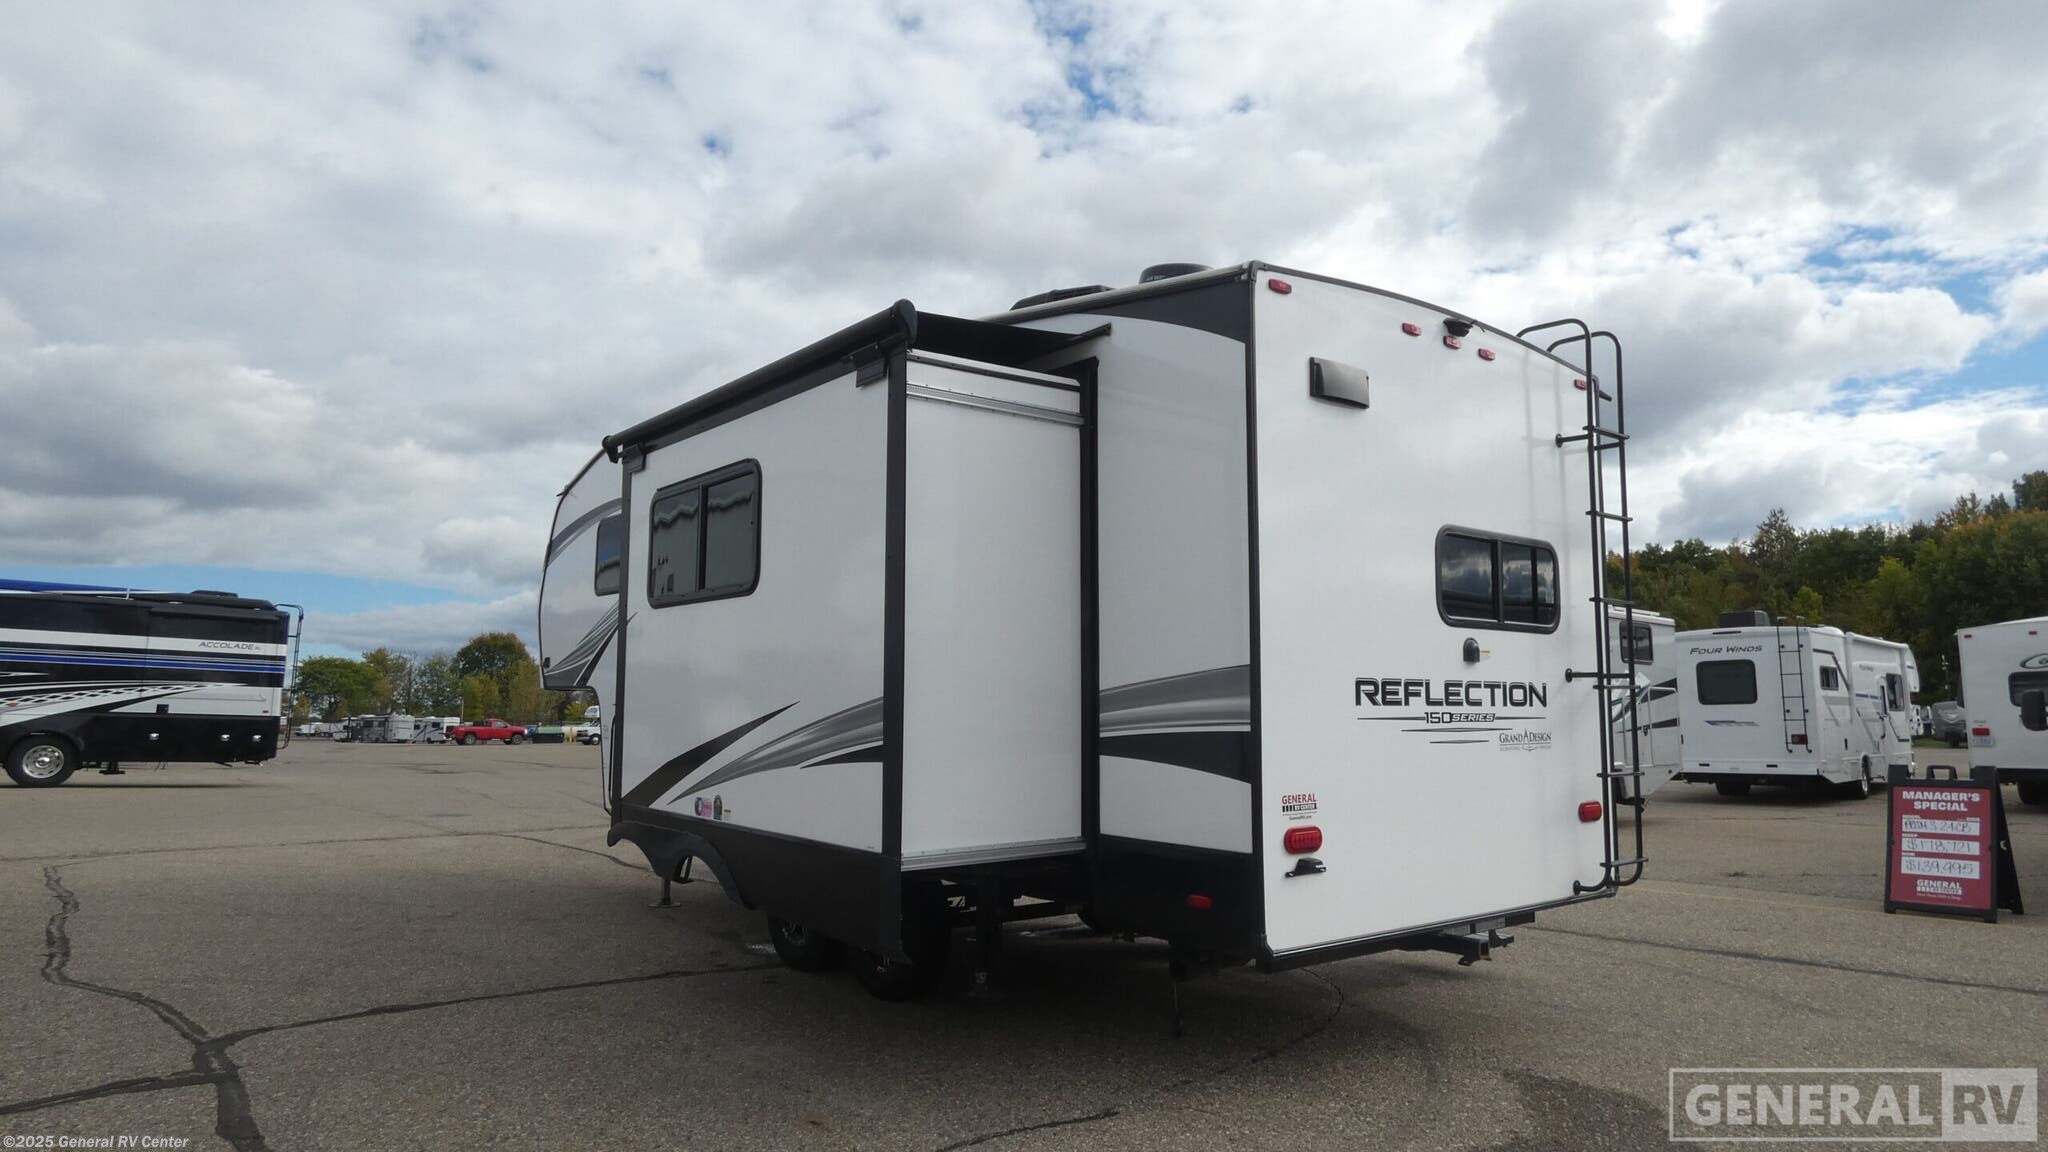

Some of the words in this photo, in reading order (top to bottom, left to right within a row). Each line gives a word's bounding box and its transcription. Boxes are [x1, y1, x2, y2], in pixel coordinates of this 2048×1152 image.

[198, 641, 255, 650] ACCOLADE
[1690, 647, 1723, 655] FOUR
[1726, 645, 1764, 653] WINDS
[1355, 677, 1548, 708] REFLECTION
[1451, 712, 1496, 723] SERIES
[1499, 732, 1523, 743] GRAND
[1529, 731, 1552, 742] DESIGN
[1282, 793, 1317, 805] GENERAL
[1902, 791, 1981, 802] MANAGER'S
[1913, 801, 1969, 811] SPECIAL
[1916, 879, 1962, 889] GENERAL
